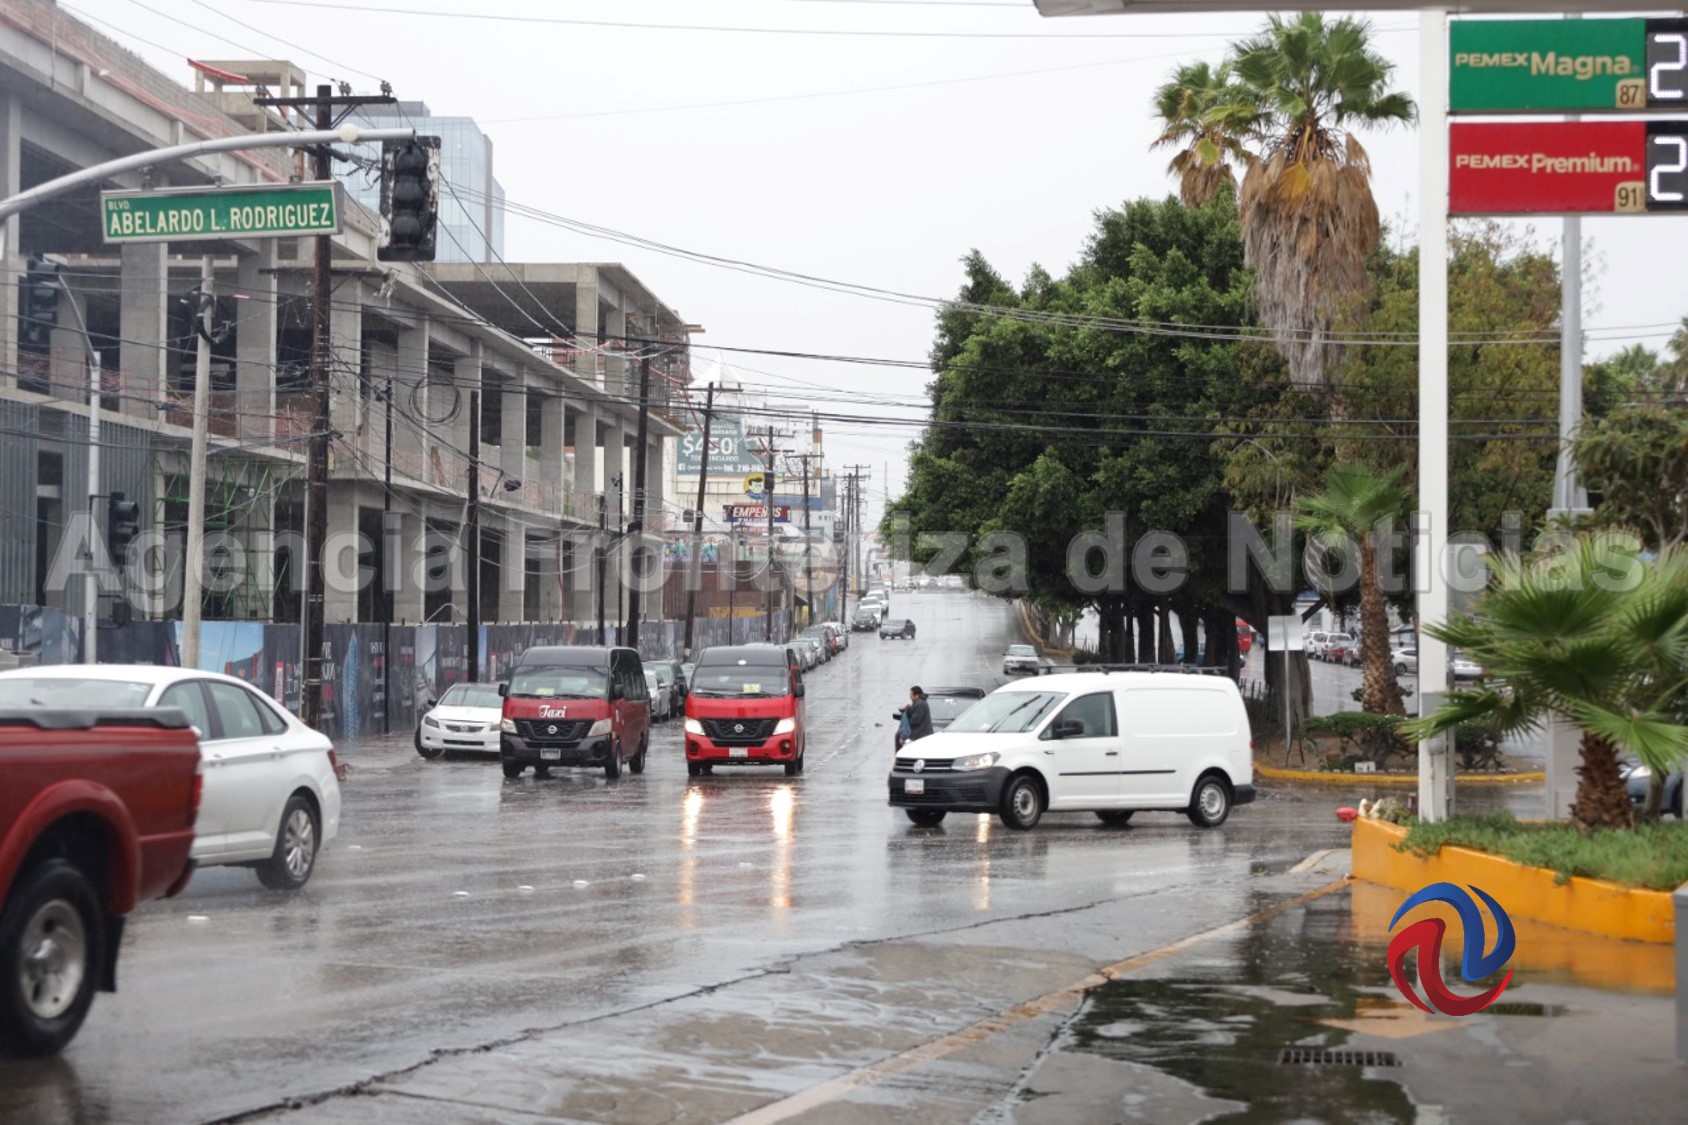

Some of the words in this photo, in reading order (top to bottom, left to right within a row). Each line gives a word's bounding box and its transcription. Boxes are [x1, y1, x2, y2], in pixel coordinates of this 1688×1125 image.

[1455, 53, 1529, 67] PEMEX
[1531, 52, 1632, 80] Magna
[1619, 85, 1640, 105] 87
[1456, 154, 1529, 169] PEMEX
[1531, 152, 1632, 174] Premium
[1618, 187, 1638, 207] 91
[110, 209, 202, 235] ABELARDO
[211, 209, 226, 232] L.
[230, 203, 331, 229] RODRIGUEZ
[539, 704, 567, 719] Taxi
